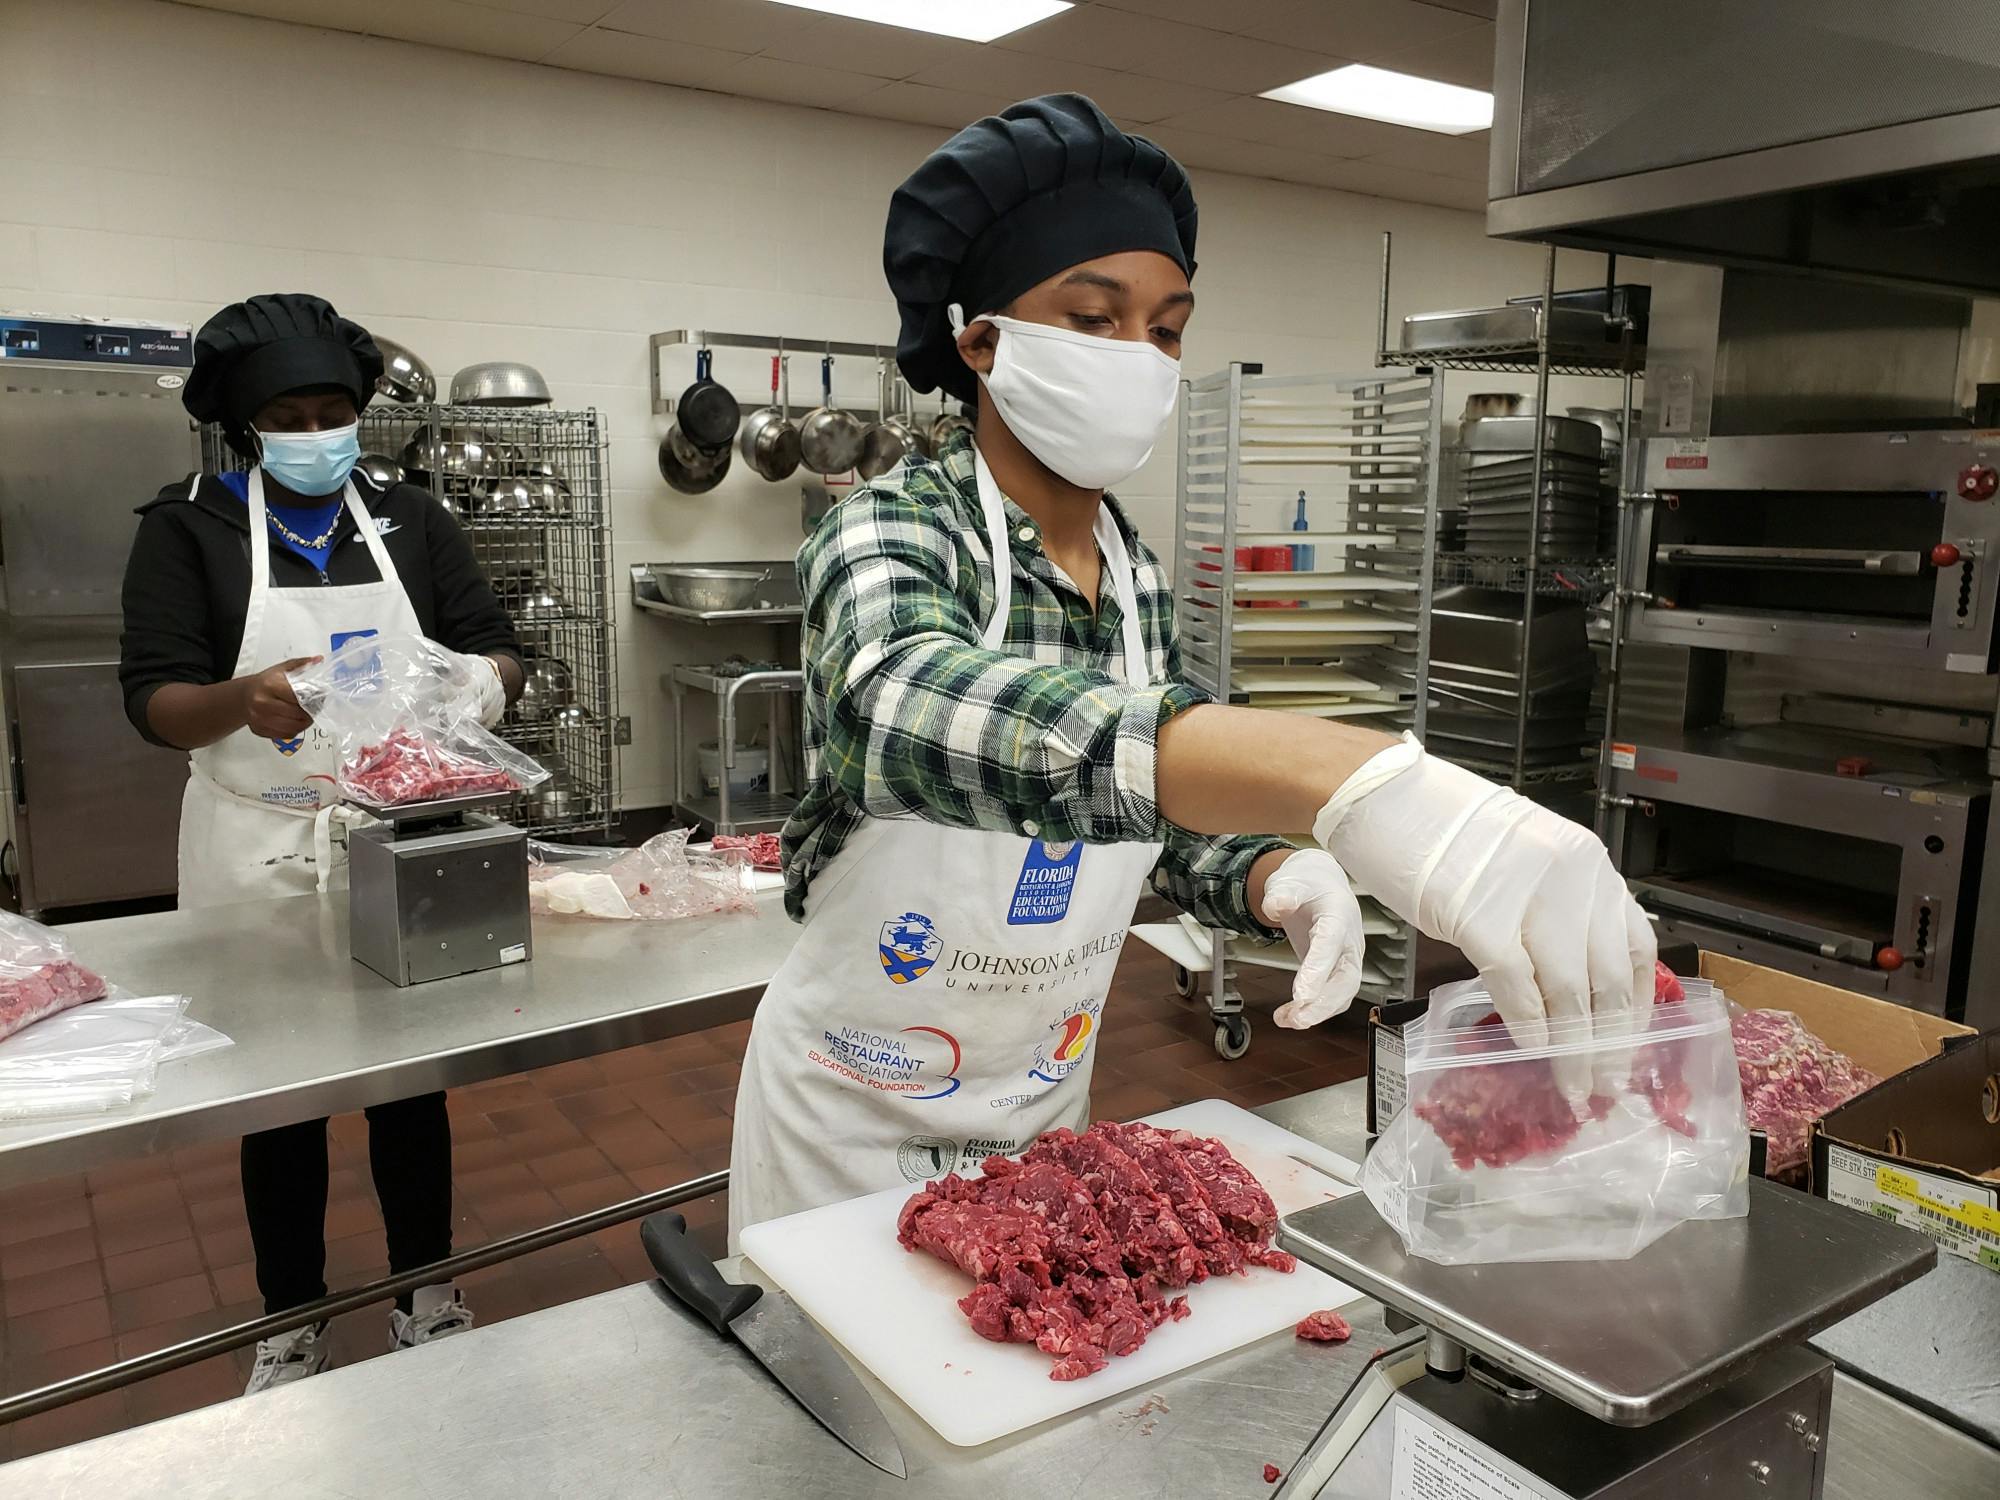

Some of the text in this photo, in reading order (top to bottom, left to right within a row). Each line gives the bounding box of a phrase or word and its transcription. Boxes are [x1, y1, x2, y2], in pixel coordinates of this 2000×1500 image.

[271, 785, 311, 793] NATIONAL
[1022, 865, 1074, 883] FLORIDA
[1012, 902, 1067, 917] FOUNDATION
[1015, 893, 1070, 907] EDUCATIONAL
[947, 929, 1124, 975] JOHNSON & WALES
[946, 967, 1091, 993] UNIVERSITY
[1049, 998, 1100, 1031] KEISER
[825, 1030, 925, 1071] RESTAURANT
[841, 1026, 907, 1053] NATIONAL
[808, 1050, 926, 1091] EDUCATIONAL FOUNDATION
[828, 1047, 912, 1080] ASSOCIATION
[965, 1139, 1015, 1149] FLORIDA
[961, 1161, 968, 1172] &
[1831, 1155, 1848, 1168] BEEF
[1849, 1161, 1861, 1174] STK
[1433, 1431, 1446, 1442] Care
[1459, 1448, 1494, 1473] Maintenance
[1504, 1476, 1520, 1490] Scale
